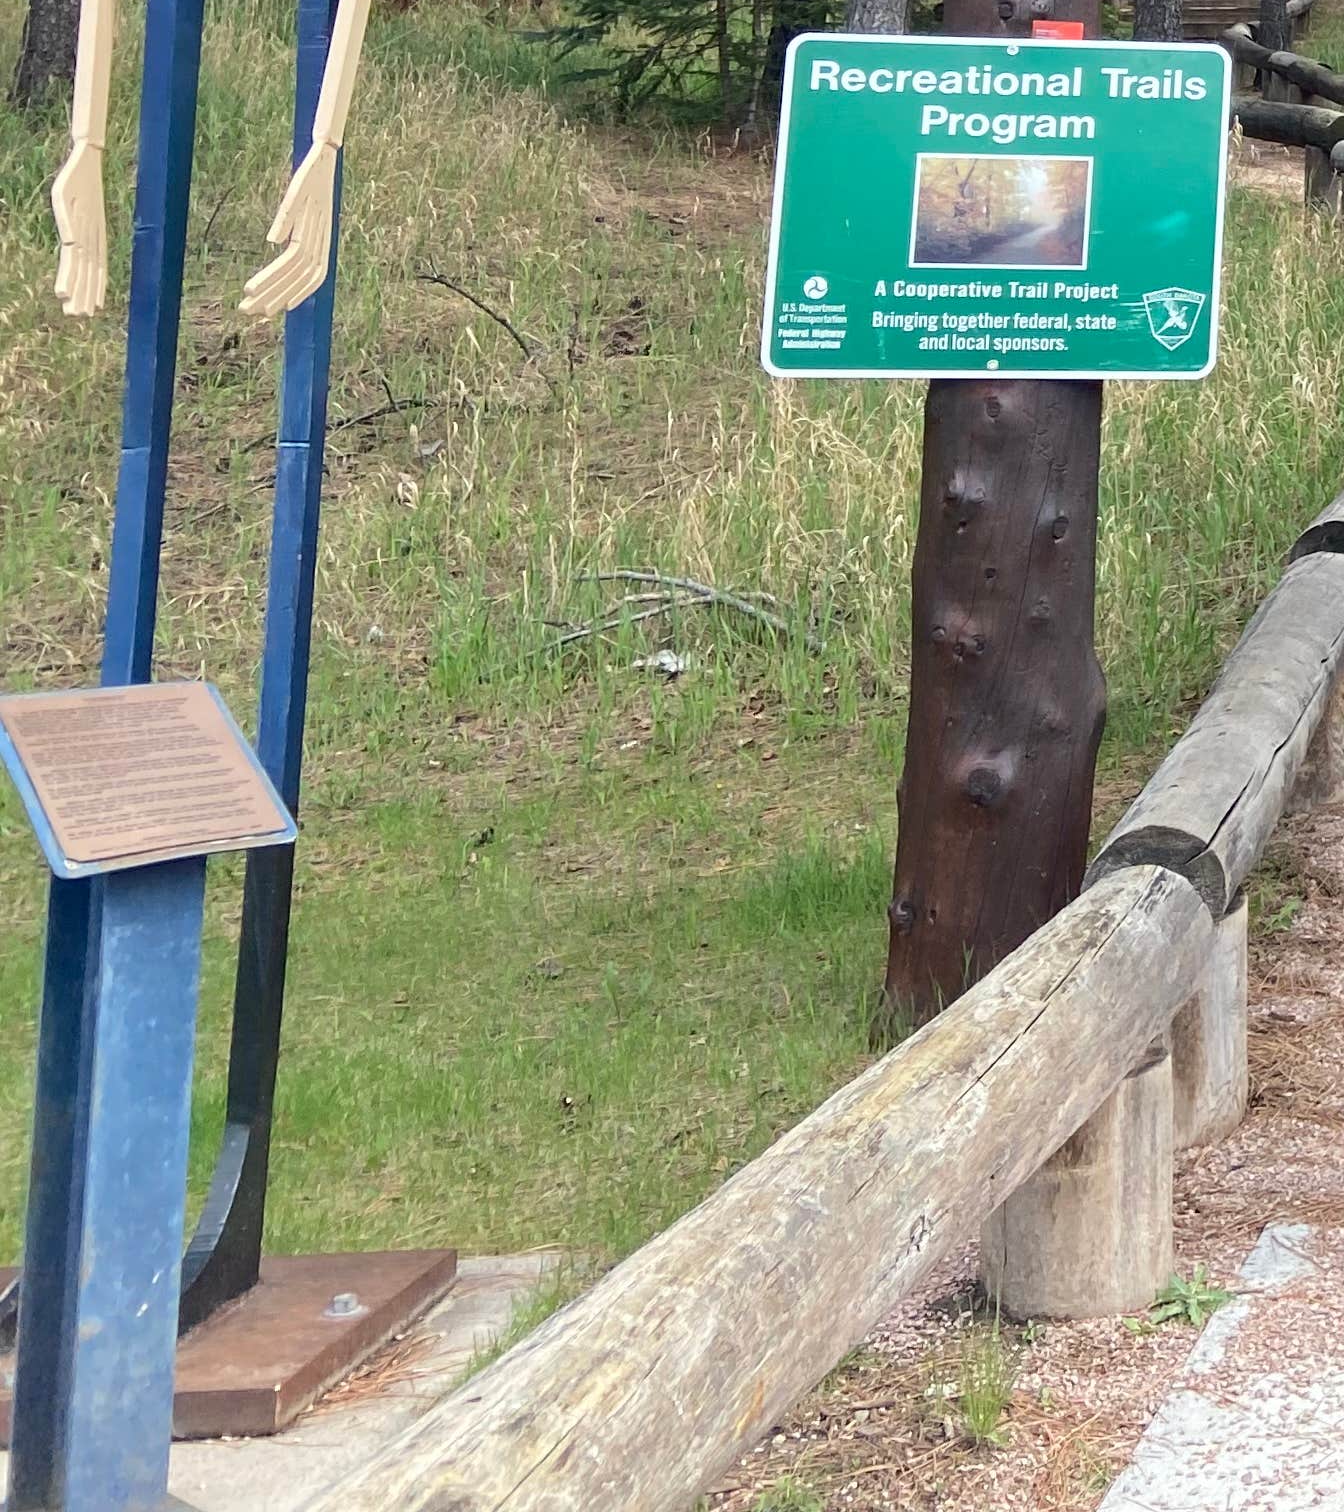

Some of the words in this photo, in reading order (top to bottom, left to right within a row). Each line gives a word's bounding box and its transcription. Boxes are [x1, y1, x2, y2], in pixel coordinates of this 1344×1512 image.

[810, 59, 1082, 98] Recreational
[1101, 67, 1207, 100] Trails
[920, 104, 1095, 144] Program
[874, 280, 887, 296] A
[893, 280, 1002, 300] Cooperative
[1008, 281, 1048, 299] Trail
[1054, 283, 1119, 302] Project
[798, 303, 846, 314] Department
[872, 311, 938, 331] Bringing
[942, 312, 1010, 332] together
[1012, 313, 1072, 331] federal,
[1075, 314, 1117, 330] state
[918, 334, 949, 350] and
[951, 334, 990, 350] local
[993, 336, 1069, 354] sponsors.
